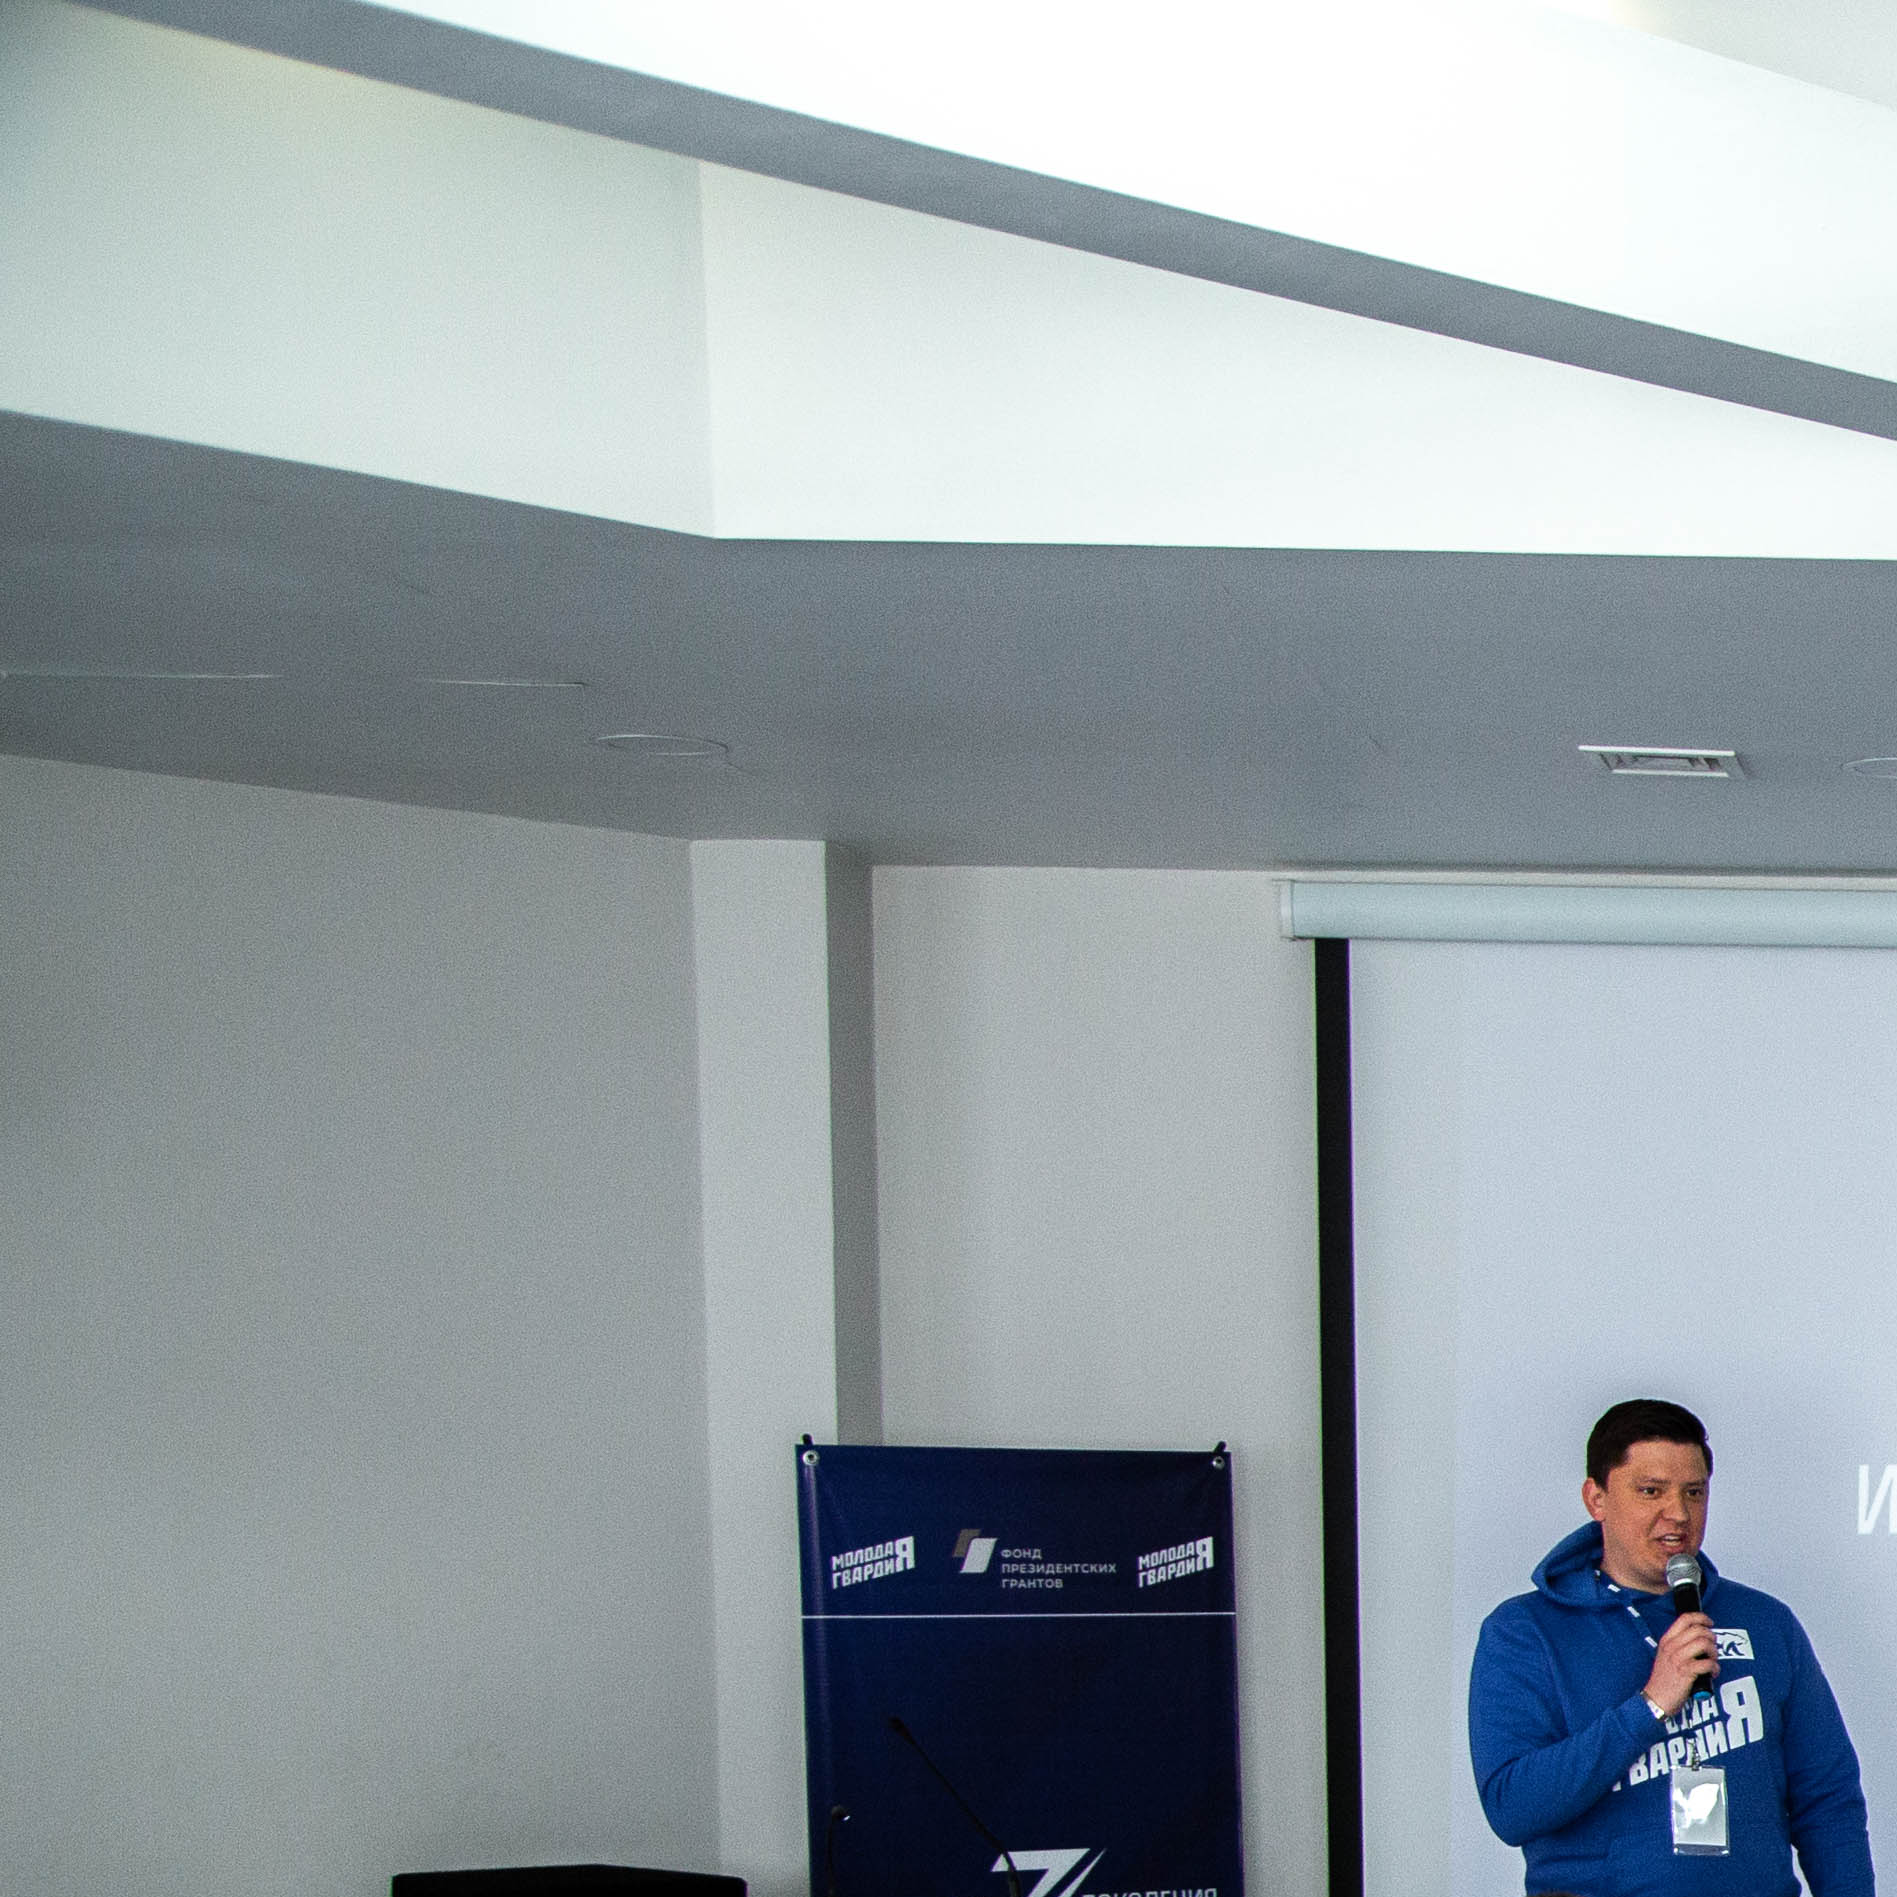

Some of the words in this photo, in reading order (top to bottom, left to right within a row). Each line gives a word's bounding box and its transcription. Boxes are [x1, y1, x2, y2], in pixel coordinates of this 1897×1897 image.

[1001, 1548, 1042, 1561] ФОНД
[1001, 1563, 1117, 1575] ПРЕЗИДЕНТСКИХ
[1001, 1578, 1064, 1589] ГРАНТОВ
